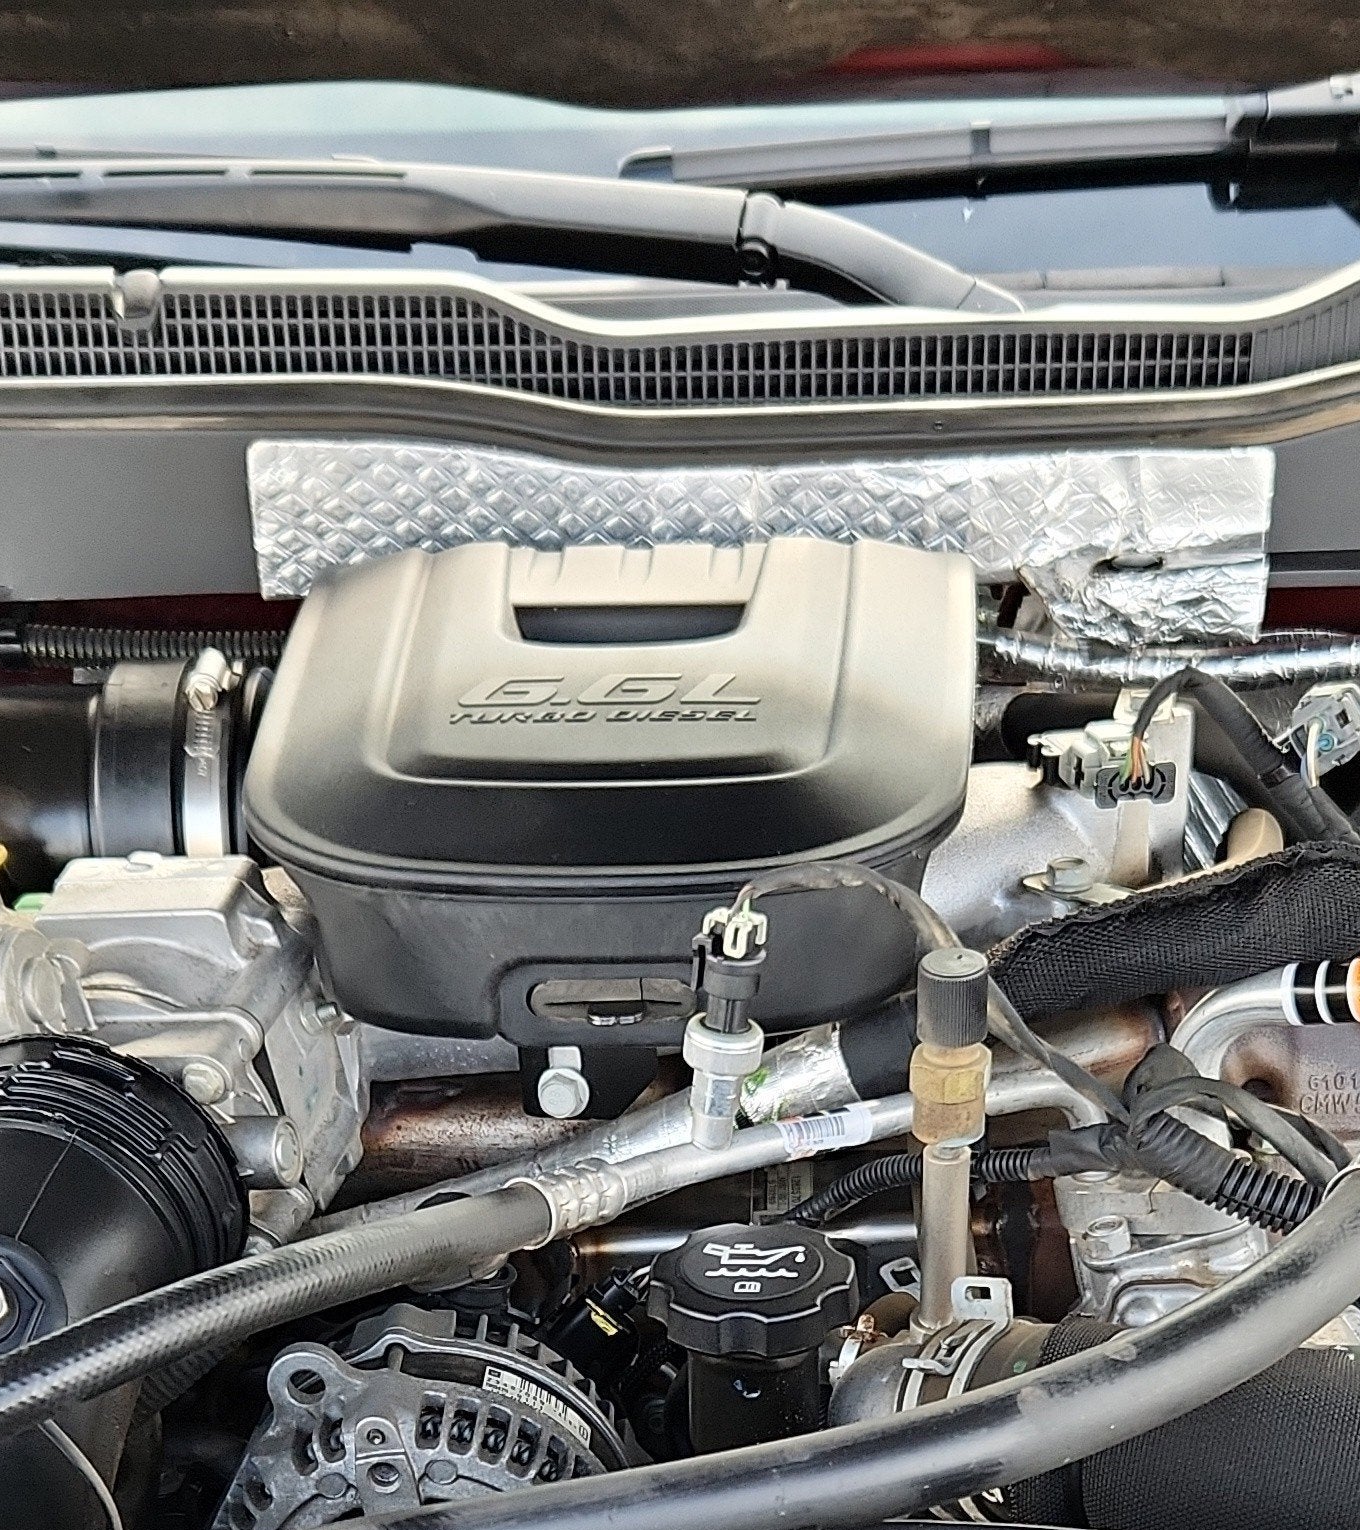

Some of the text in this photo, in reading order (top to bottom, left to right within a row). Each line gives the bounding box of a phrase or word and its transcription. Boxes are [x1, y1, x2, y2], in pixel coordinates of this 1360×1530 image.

[457, 672, 761, 707] 6.6L
[449, 709, 757, 725] TURBO DIESEL
